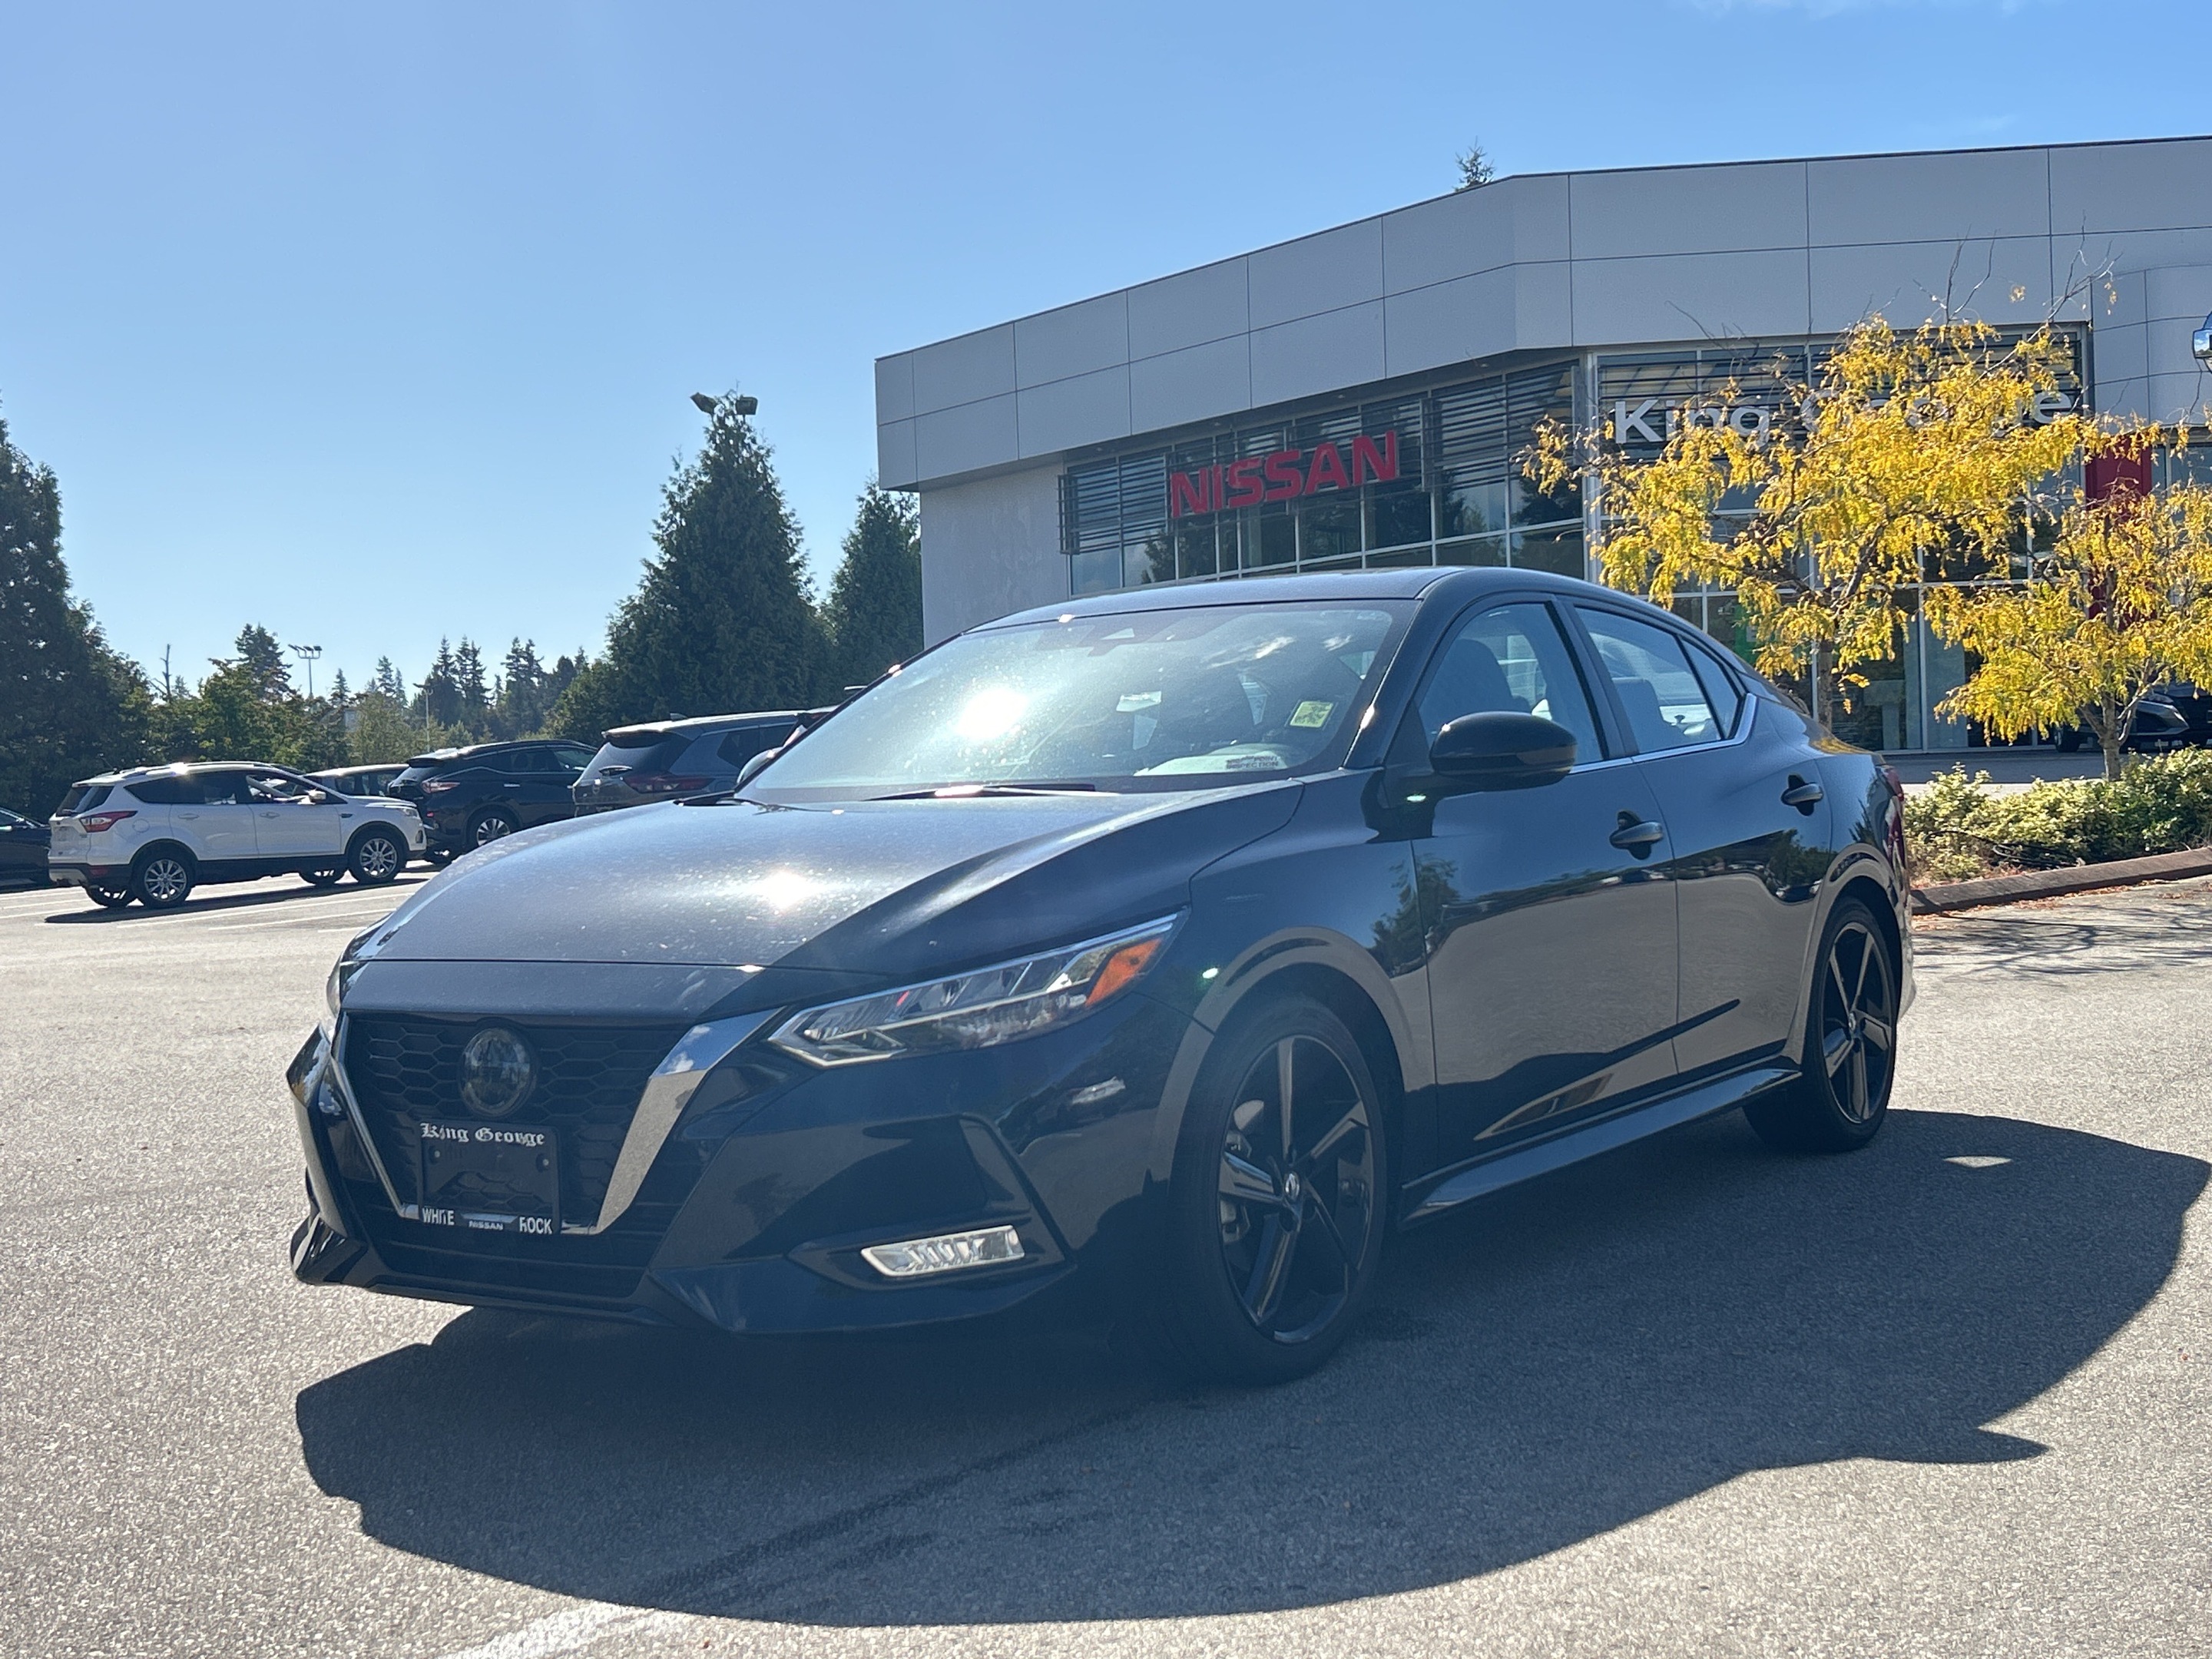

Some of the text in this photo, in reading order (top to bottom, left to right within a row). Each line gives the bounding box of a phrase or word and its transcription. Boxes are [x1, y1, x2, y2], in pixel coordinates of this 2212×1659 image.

[1615, 399, 1770, 450] King
[1170, 430, 1399, 518] NISSAN
[420, 1123, 545, 1147] King George
[422, 1207, 553, 1235] WHITE NISSAN ROCK
